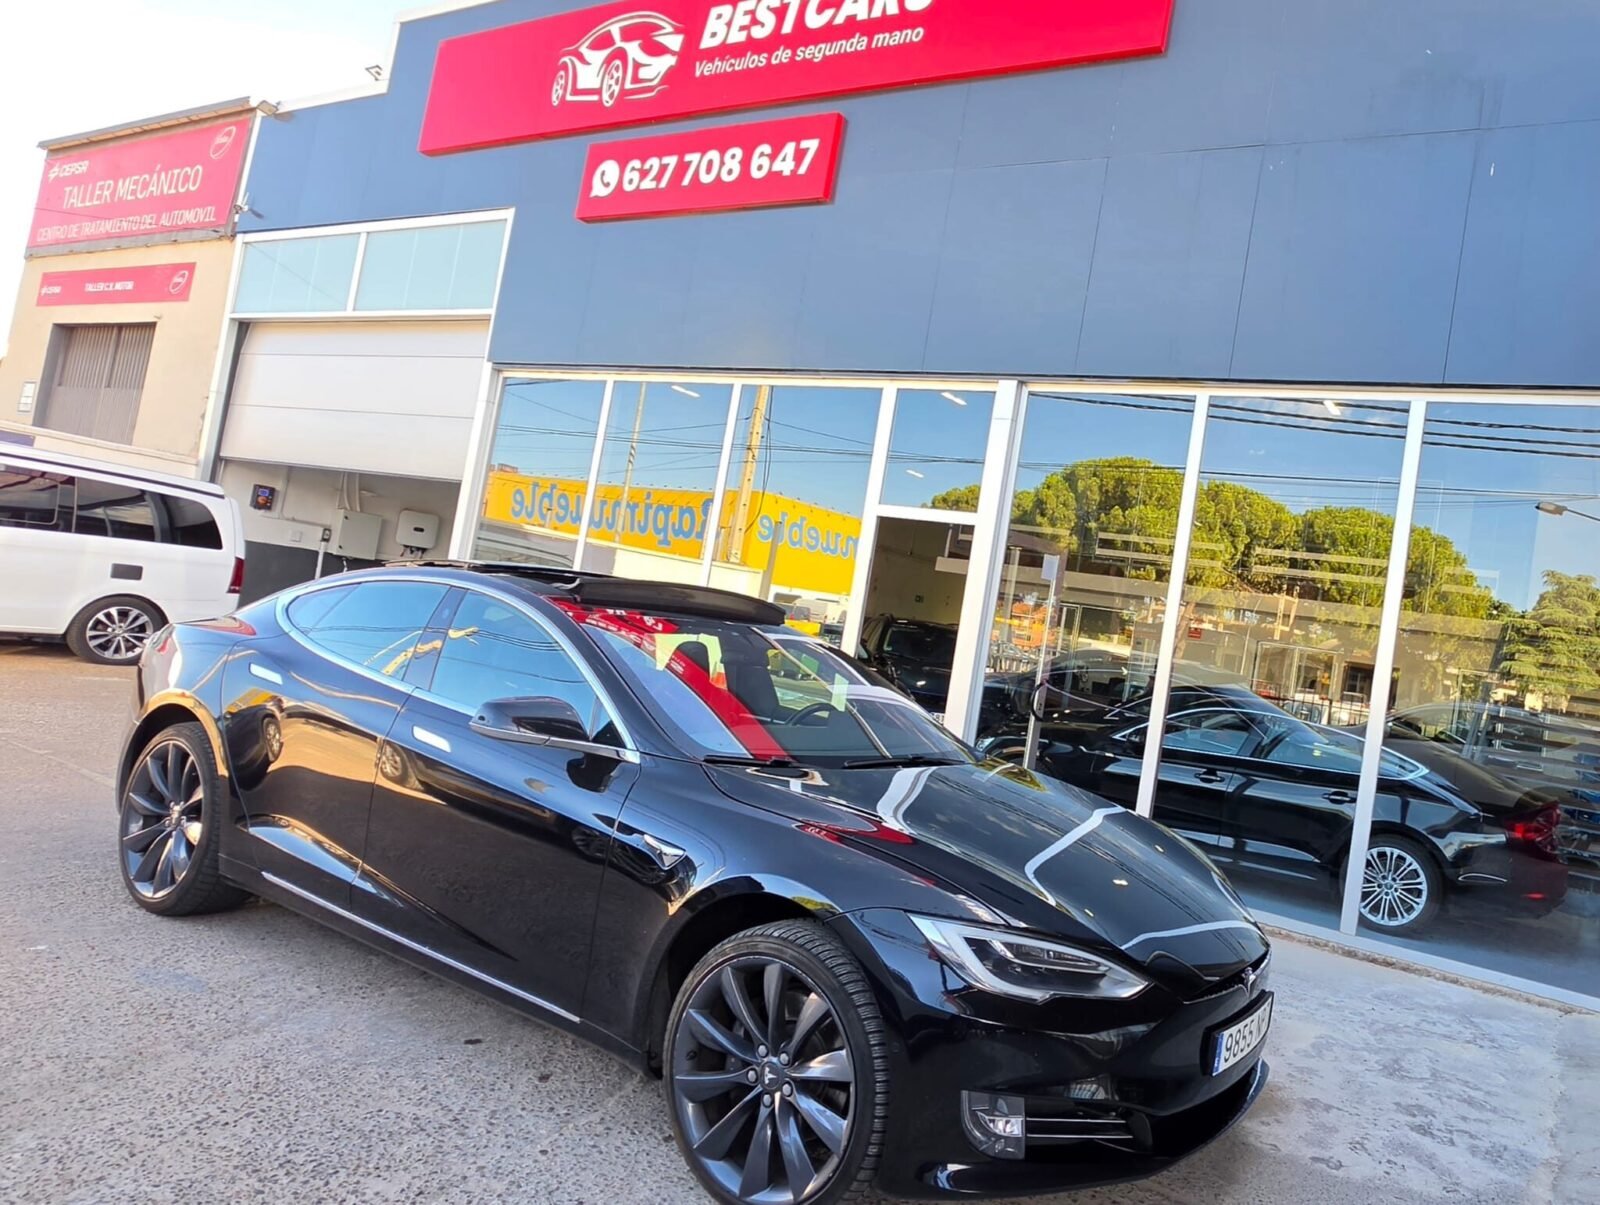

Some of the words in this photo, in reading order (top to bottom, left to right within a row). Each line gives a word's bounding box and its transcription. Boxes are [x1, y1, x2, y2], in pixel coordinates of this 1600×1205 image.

[699, 0, 933, 49] BESTCA
[694, 50, 767, 78] Vehículos
[771, 45, 792, 64] de
[796, 32, 867, 62] segunda
[871, 26, 925, 49] mano
[63, 180, 114, 209] TALLER
[114, 163, 203, 202] MECÁNICO
[622, 153, 678, 192] 627
[681, 147, 743, 186] 708
[749, 138, 820, 180] 647
[36, 225, 67, 242] CENTRO
[67, 223, 80, 239] DE
[80, 214, 140, 237] TRATAMIENTO
[140, 213, 157, 230] DEL
[1223, 1019, 1255, 1063] 9855
